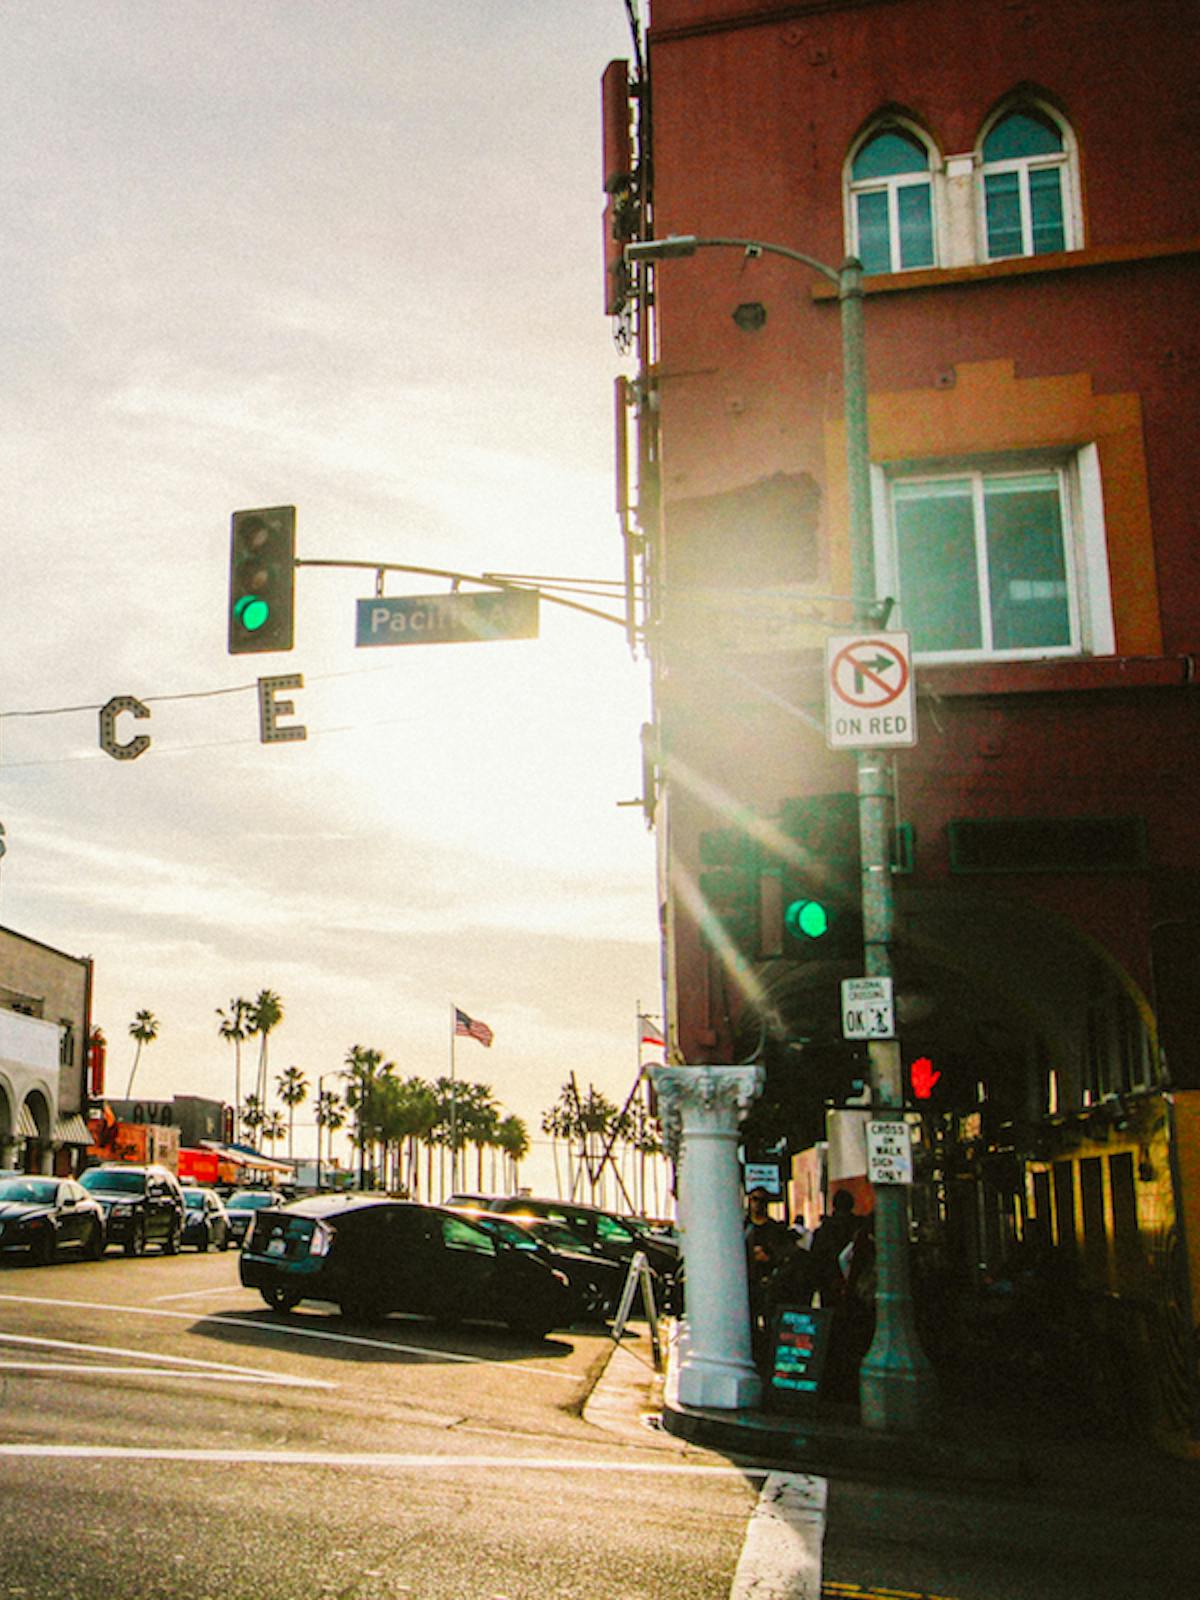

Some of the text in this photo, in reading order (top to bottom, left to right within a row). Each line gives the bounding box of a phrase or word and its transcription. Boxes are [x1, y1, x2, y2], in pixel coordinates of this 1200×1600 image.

[835, 716, 907, 736] ON RED
[846, 1010, 865, 1031] OK
[871, 1124, 904, 1135] CROSS
[876, 1146, 902, 1156] WALK
[878, 1169, 902, 1181] ONLY
